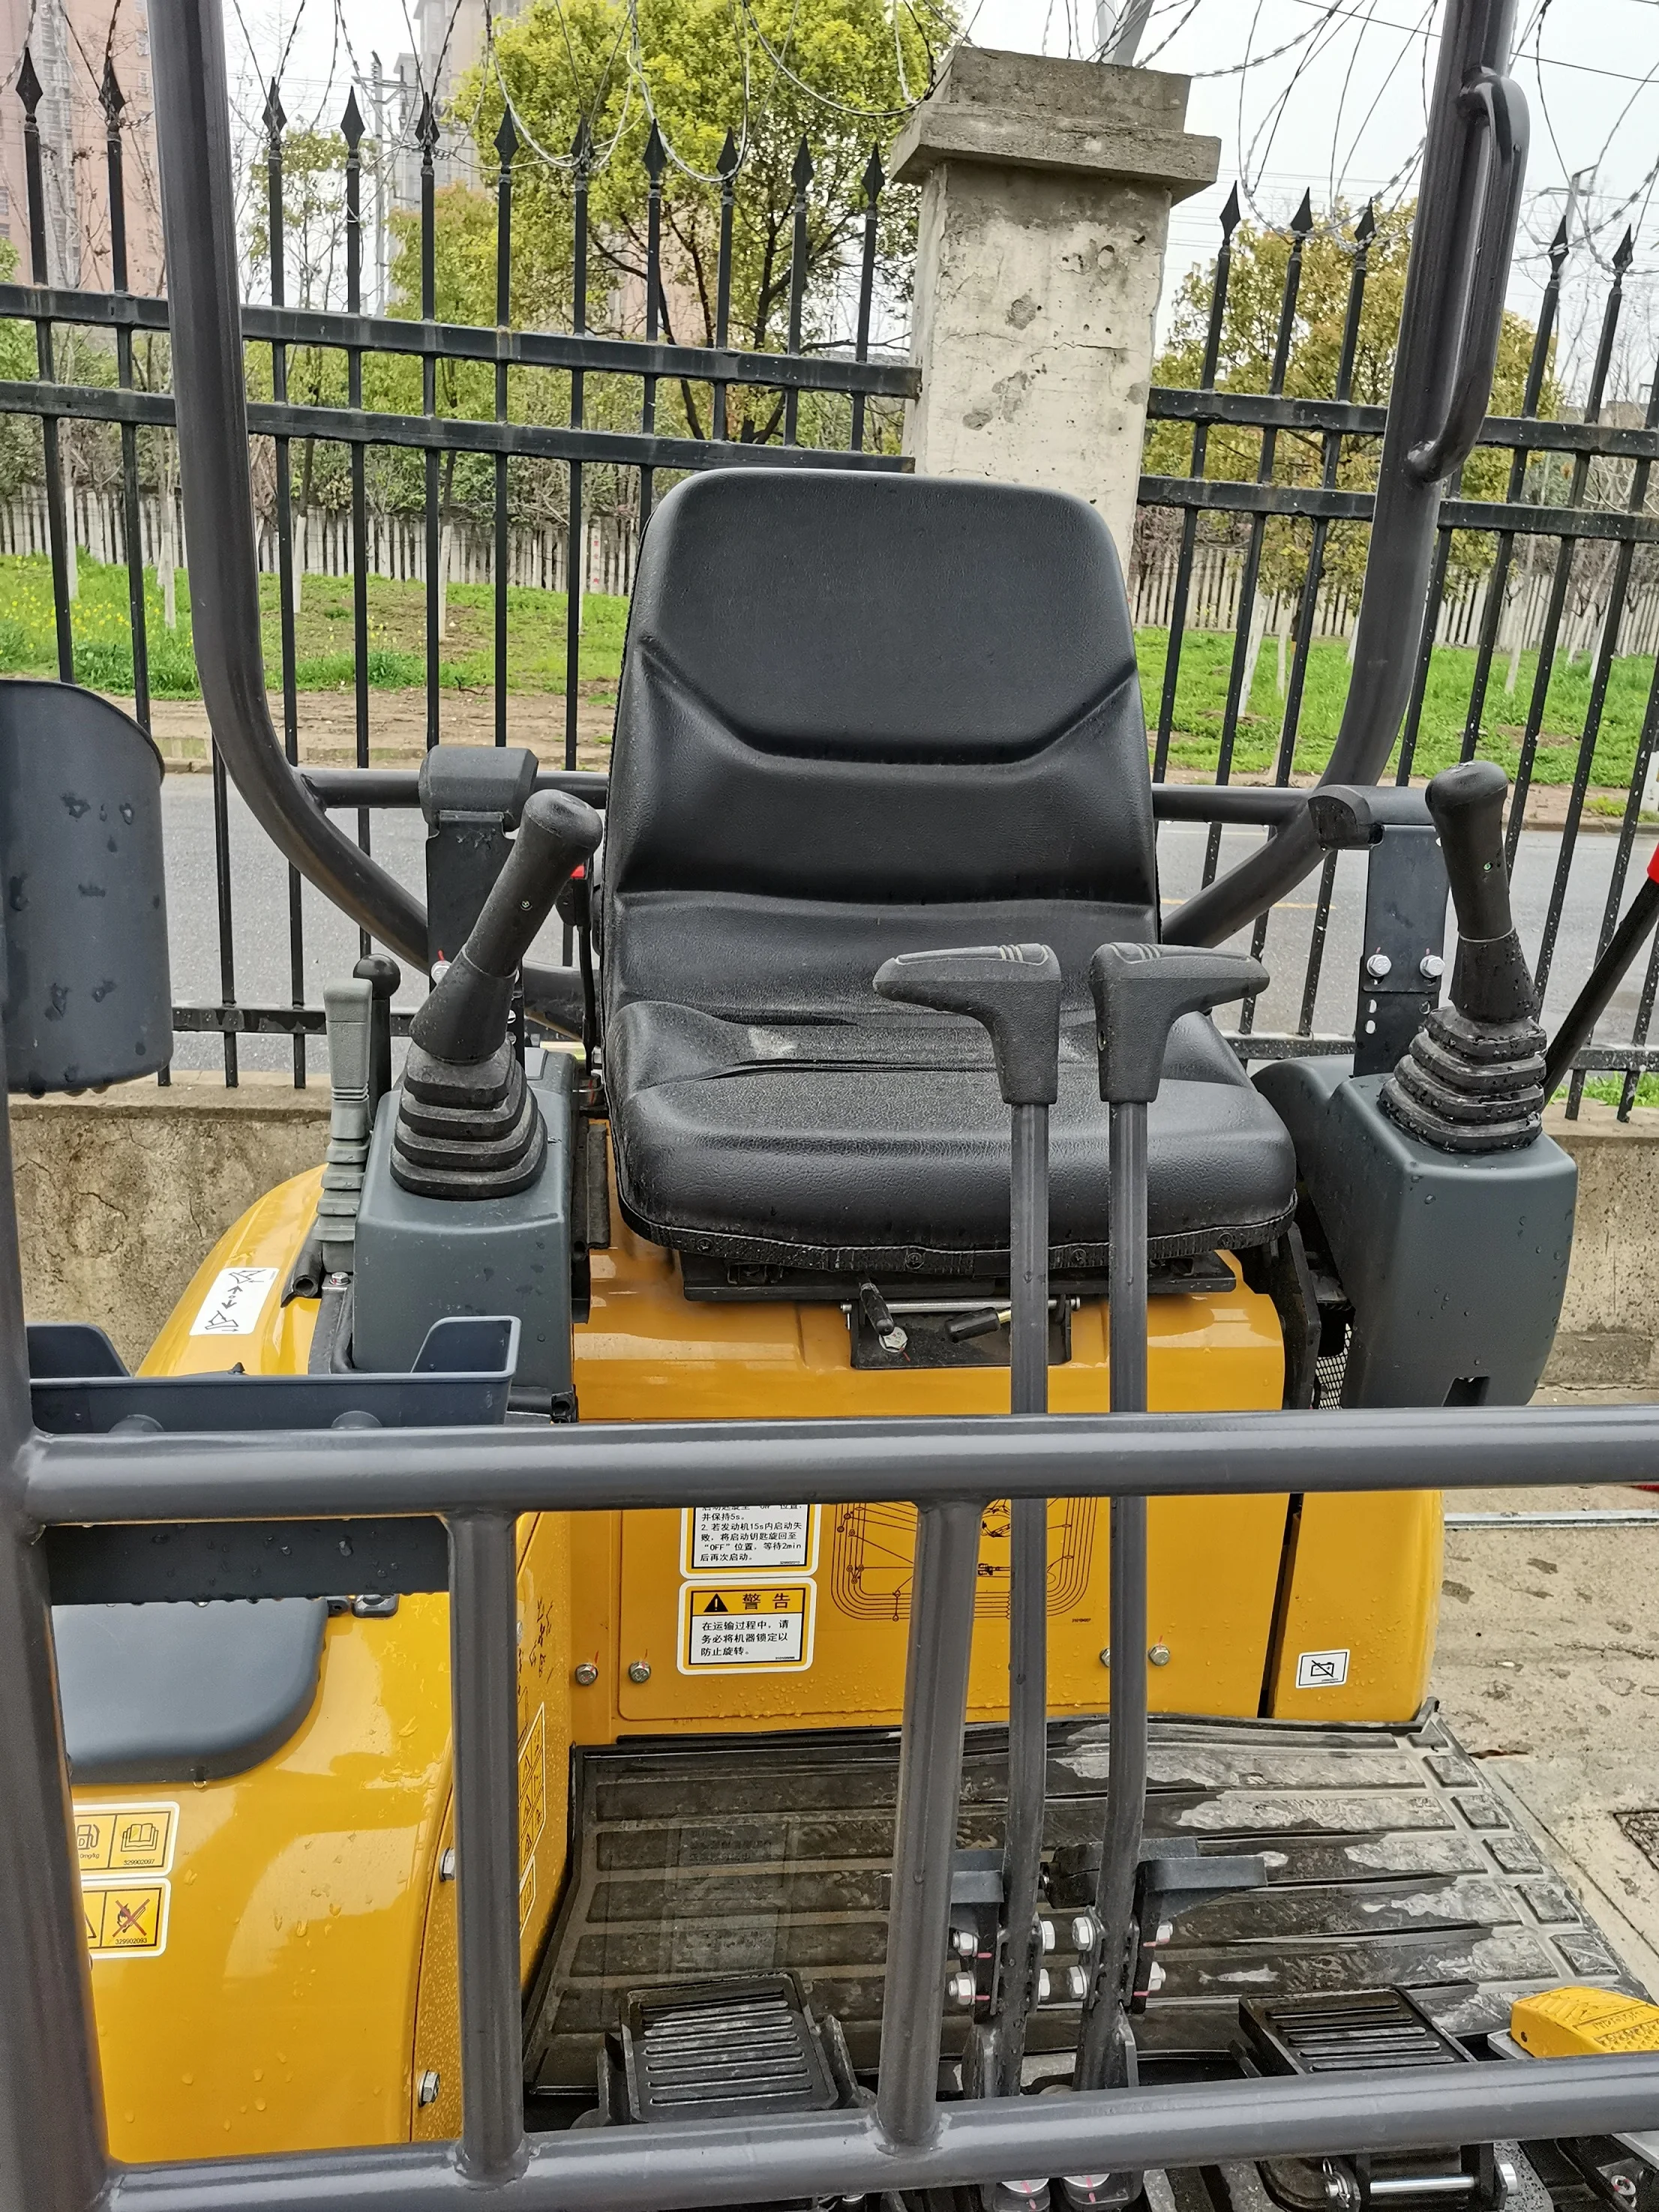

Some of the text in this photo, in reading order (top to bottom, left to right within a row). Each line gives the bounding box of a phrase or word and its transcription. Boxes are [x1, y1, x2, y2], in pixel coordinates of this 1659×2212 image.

[701, 1632, 788, 1644] 务必将机器锁定以
[700, 1646, 749, 1657] 防止旋转。
